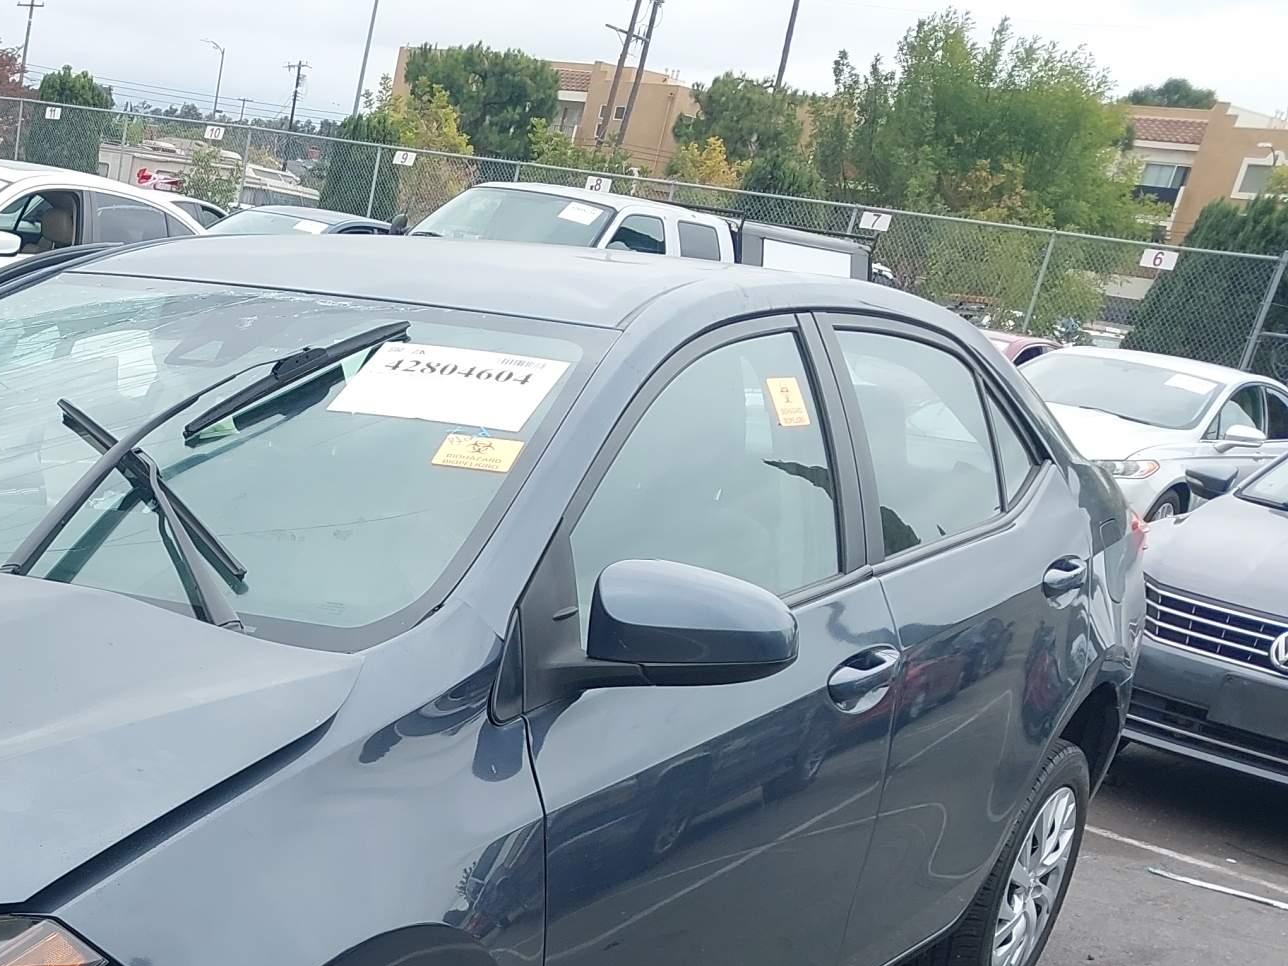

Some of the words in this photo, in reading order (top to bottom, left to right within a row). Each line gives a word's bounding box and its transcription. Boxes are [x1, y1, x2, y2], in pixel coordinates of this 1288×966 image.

[209, 127, 221, 138] 10
[400, 152, 409, 164] 9
[872, 213, 882, 228] 7
[1152, 251, 1165, 267] 6
[384, 358, 534, 386] 42804604
